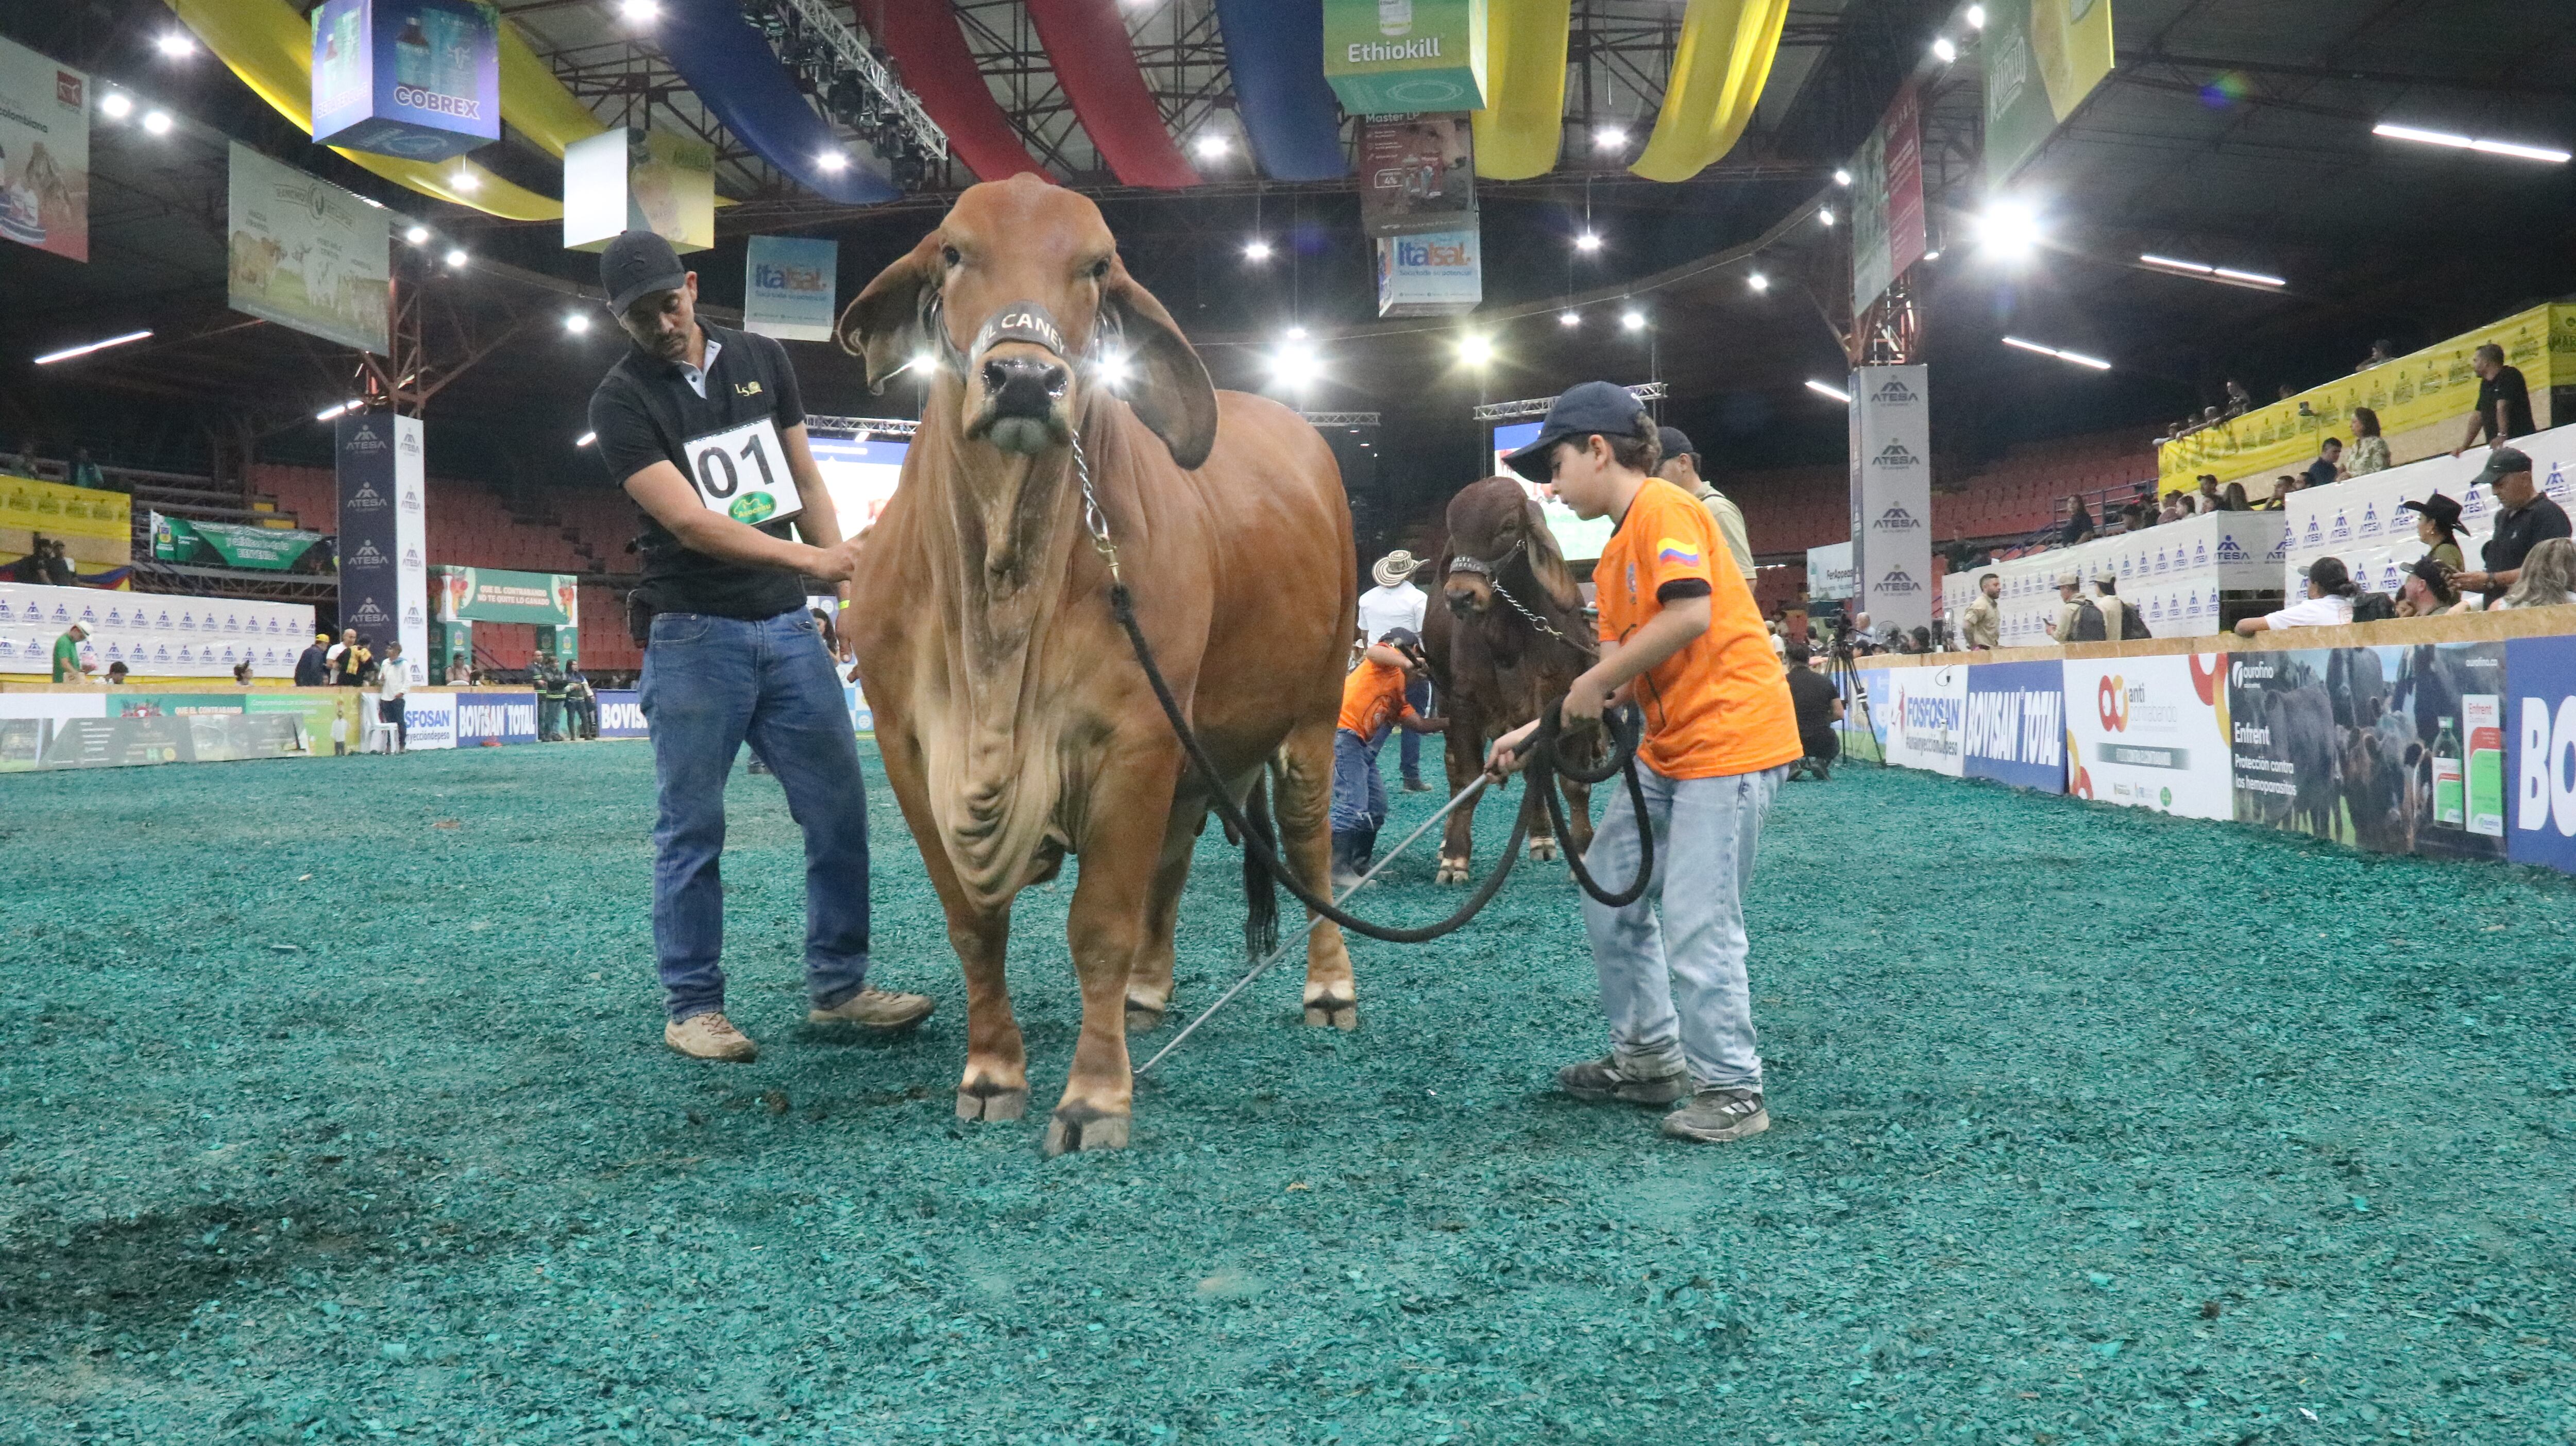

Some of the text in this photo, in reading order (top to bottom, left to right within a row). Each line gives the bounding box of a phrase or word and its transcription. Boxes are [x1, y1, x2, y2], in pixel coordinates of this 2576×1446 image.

[1348, 37, 1440, 62] Ethiokill
[394, 87, 480, 120] COBREX
[1366, 112, 1403, 123] Master
[981, 313, 1065, 354] EL CANEY
[1871, 393, 1918, 402] ATESA
[346, 440, 386, 450] ATESA
[400, 443, 420, 454] ATESA
[1872, 456, 1920, 465] ATESA
[698, 434, 774, 499] 01
[347, 498, 388, 507] ATESA
[401, 500, 421, 511] ATESA
[1872, 519, 1921, 528] ATESA
[2359, 522, 2382, 534] ATESA
[2303, 533, 2324, 543] ATESA
[2330, 528, 2352, 539] ATESA
[348, 556, 388, 565] ATESA
[2213, 551, 2250, 560] ATESA
[402, 558, 422, 567] ATESA
[1873, 582, 1922, 592] ATESA
[2379, 579, 2403, 589] ATESA
[502, 586, 547, 597] CONTRABANDO
[524, 597, 550, 606] GANADO
[349, 614, 390, 623] ATESA
[403, 617, 424, 625] ATESA
[2243, 661, 2274, 678] ourofino
[2128, 683, 2145, 703] anti
[1908, 696, 1959, 731] FOSFOSAN
[459, 703, 535, 737] BOVISAN TOTAL
[1965, 691, 2061, 767] BOVISAN TOTAL
[2234, 722, 2270, 745] Enfrent
[2235, 753, 2294, 774] Protección contra
[2235, 774, 2245, 789] los
